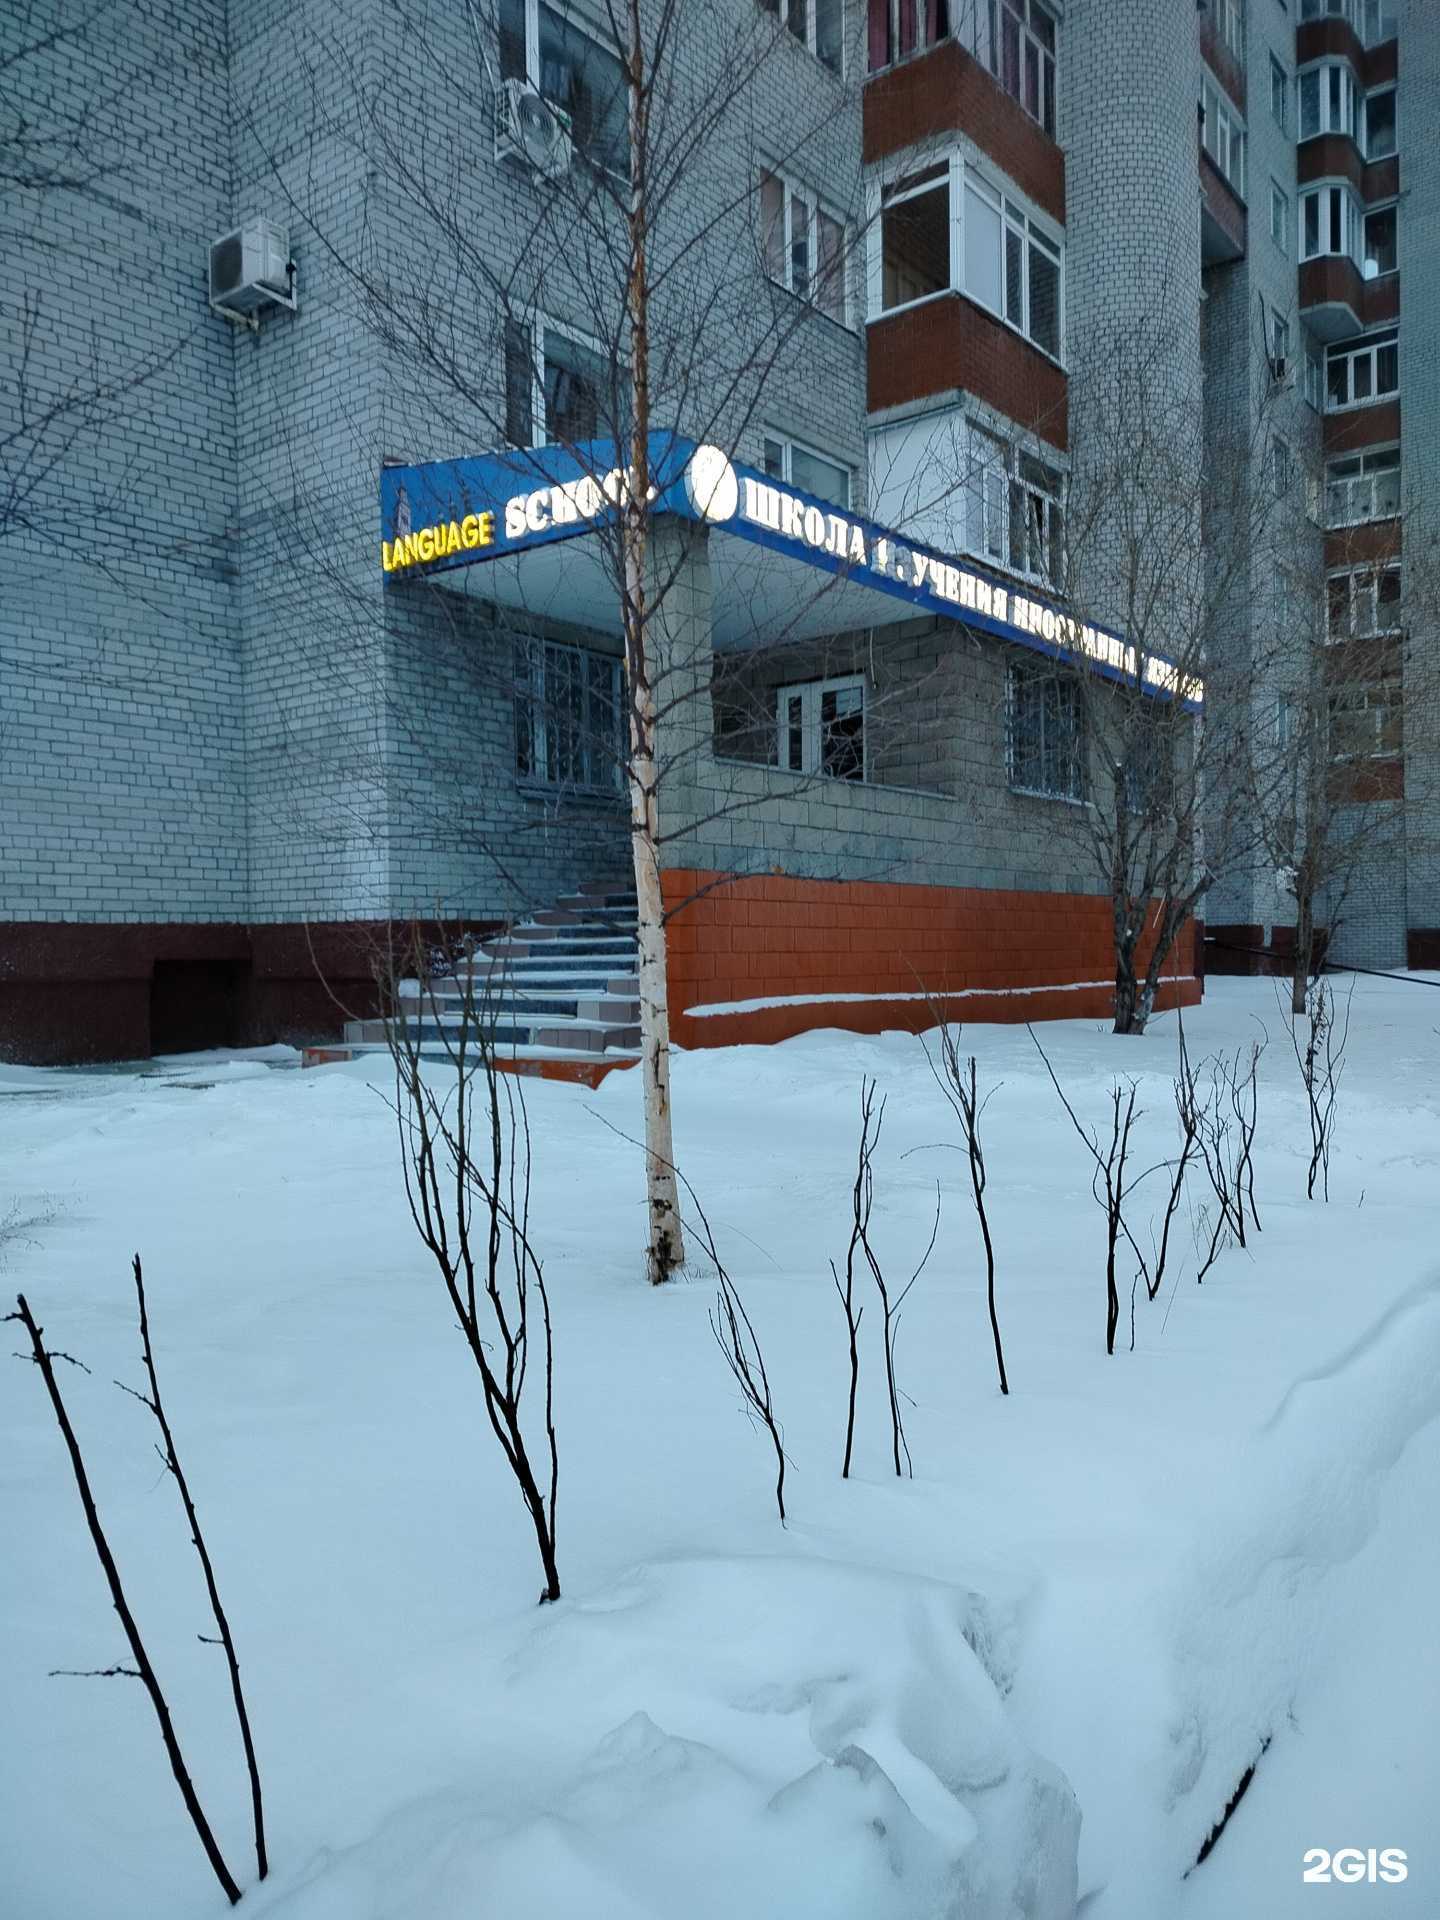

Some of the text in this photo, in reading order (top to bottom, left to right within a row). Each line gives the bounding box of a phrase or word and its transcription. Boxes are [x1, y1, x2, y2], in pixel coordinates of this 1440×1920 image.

[382, 464, 657, 572] LANGUAGE SCHOO
[743, 476, 867, 566] ШКОЛА
